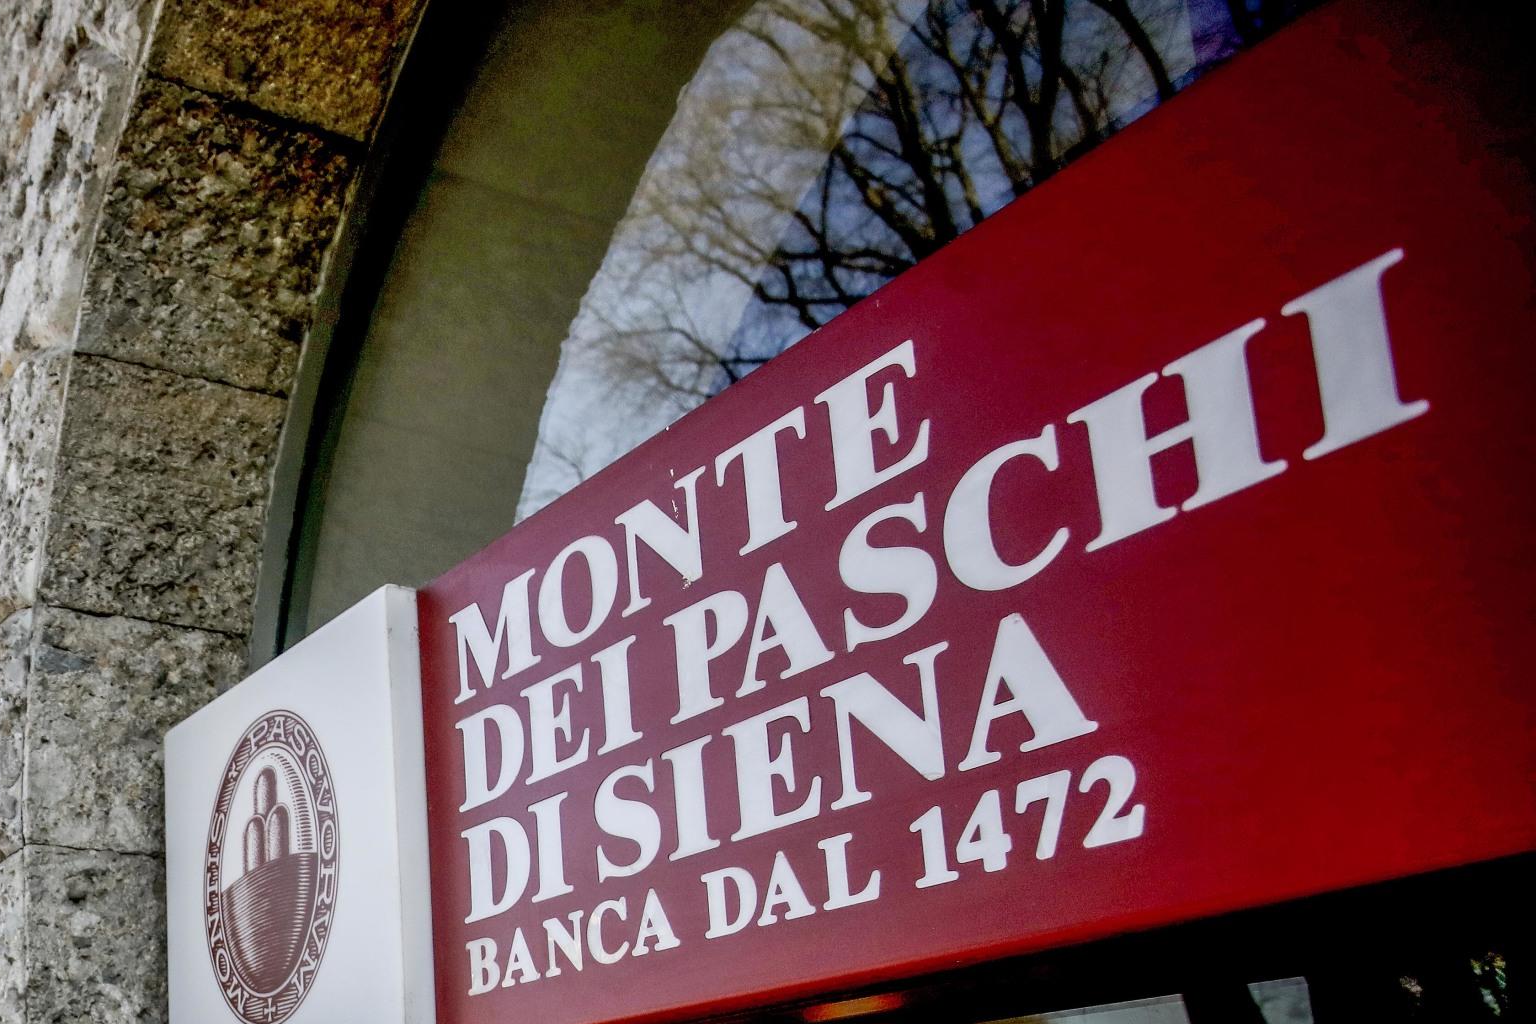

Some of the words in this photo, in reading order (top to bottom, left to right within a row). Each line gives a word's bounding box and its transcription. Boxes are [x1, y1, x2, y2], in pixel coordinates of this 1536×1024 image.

[448, 338, 932, 706] MONTE
[454, 634, 645, 814] DEI
[663, 247, 1431, 727] PASCHI
[205, 811, 250, 1015] MONTIS
[246, 715, 337, 998] PASCVORVM
[460, 790, 575, 926] DI
[594, 611, 1100, 884] SIENA
[464, 886, 682, 998] BANCA
[700, 832, 882, 941] DAL
[909, 754, 1147, 890] 1472
